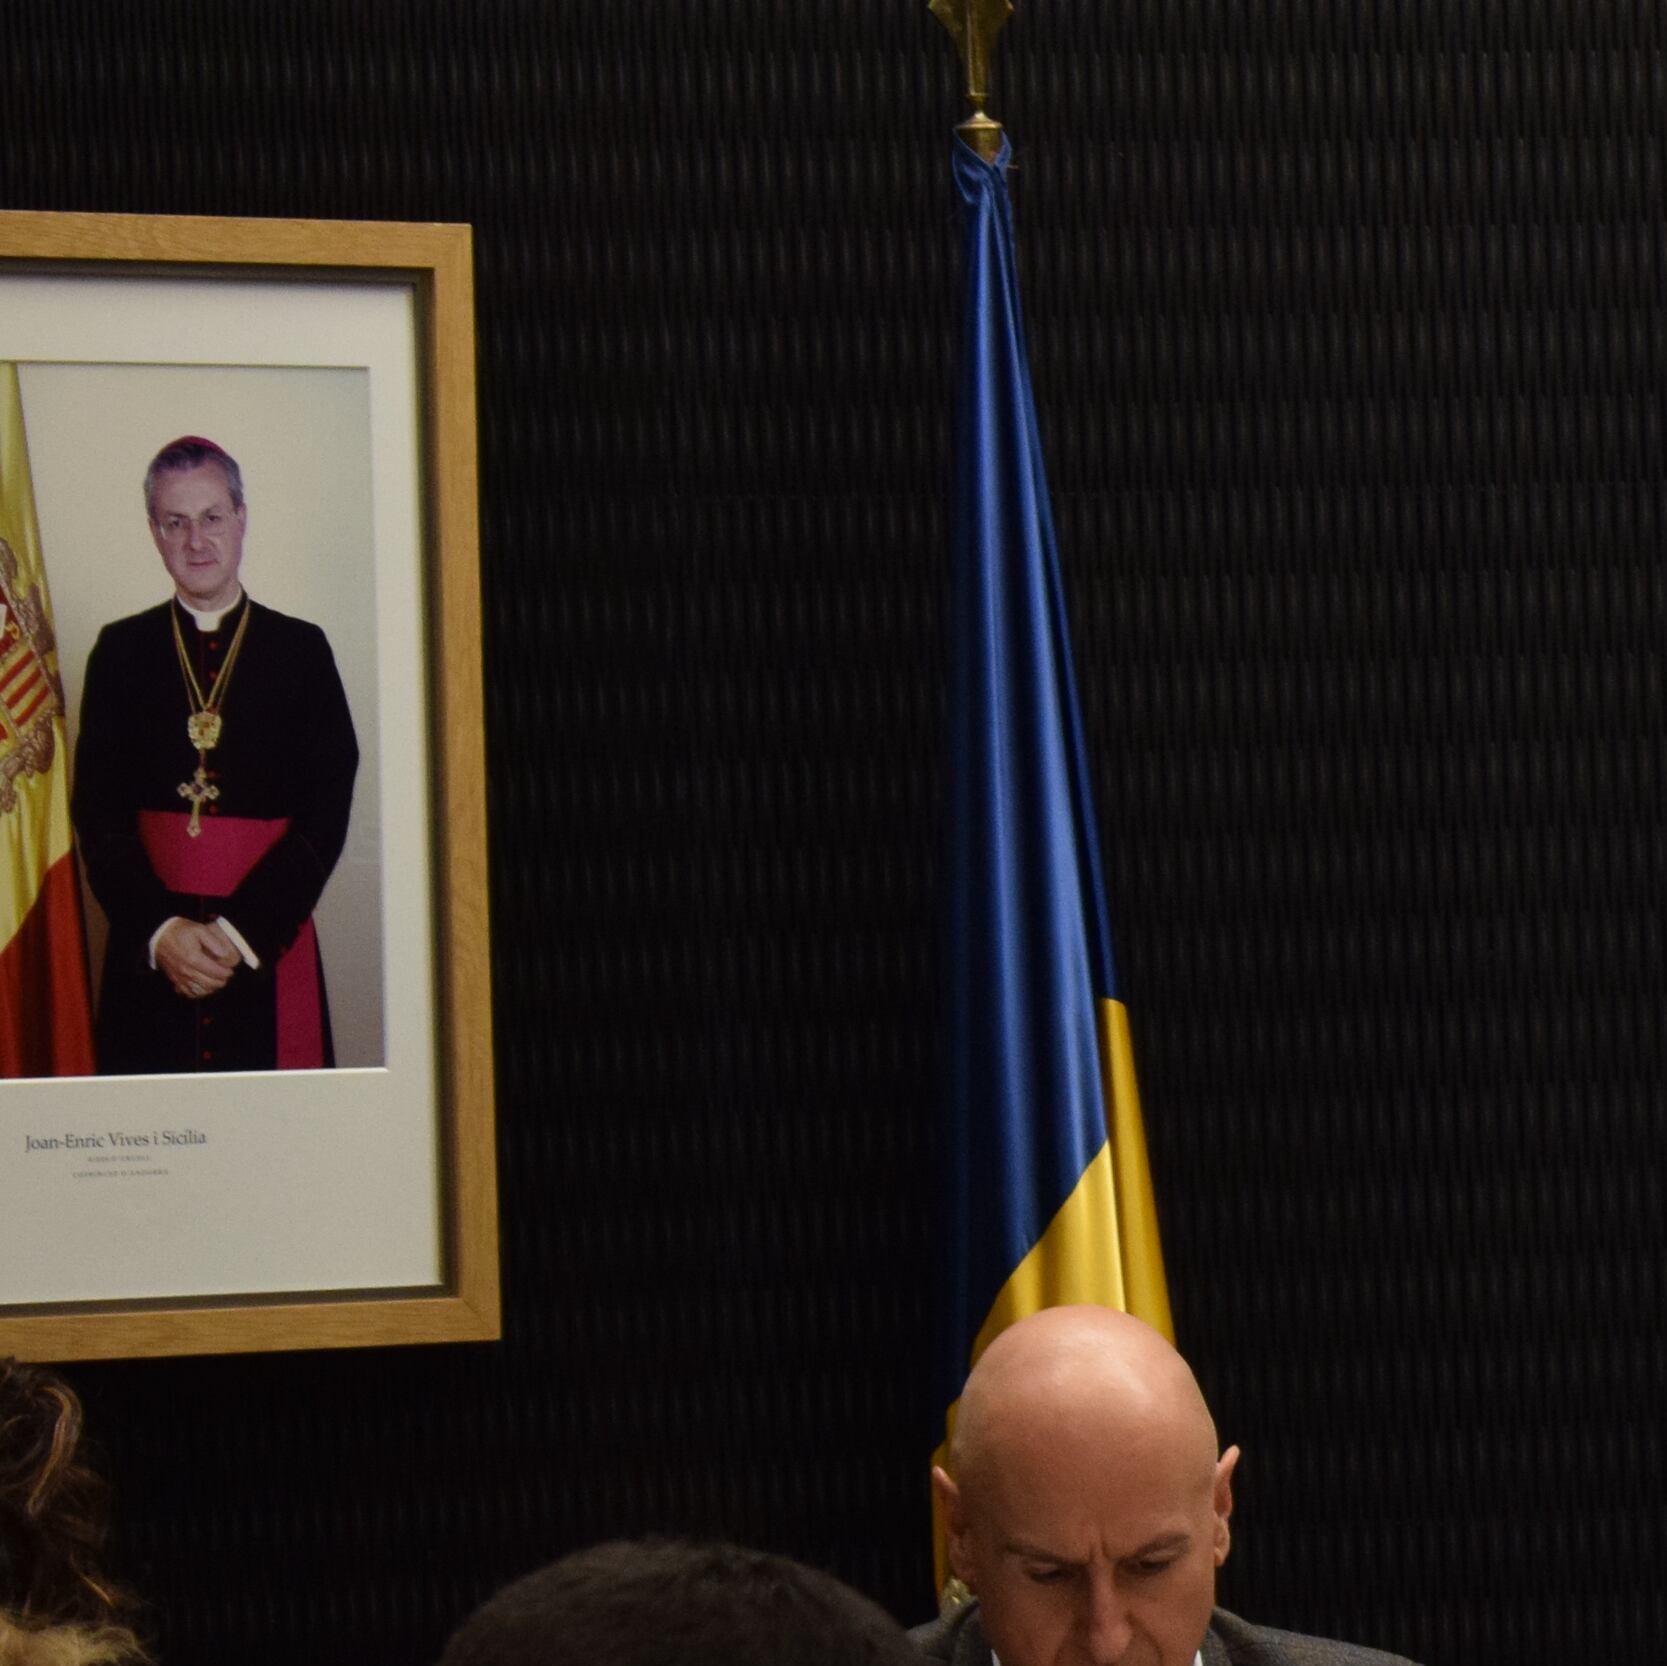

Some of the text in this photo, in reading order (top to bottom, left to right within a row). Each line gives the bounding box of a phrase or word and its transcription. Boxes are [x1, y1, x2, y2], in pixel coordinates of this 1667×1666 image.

[25, 1133, 104, 1152] Joan-Enric
[108, 1131, 150, 1148] Vives
[162, 1129, 207, 1146] Sicilia
